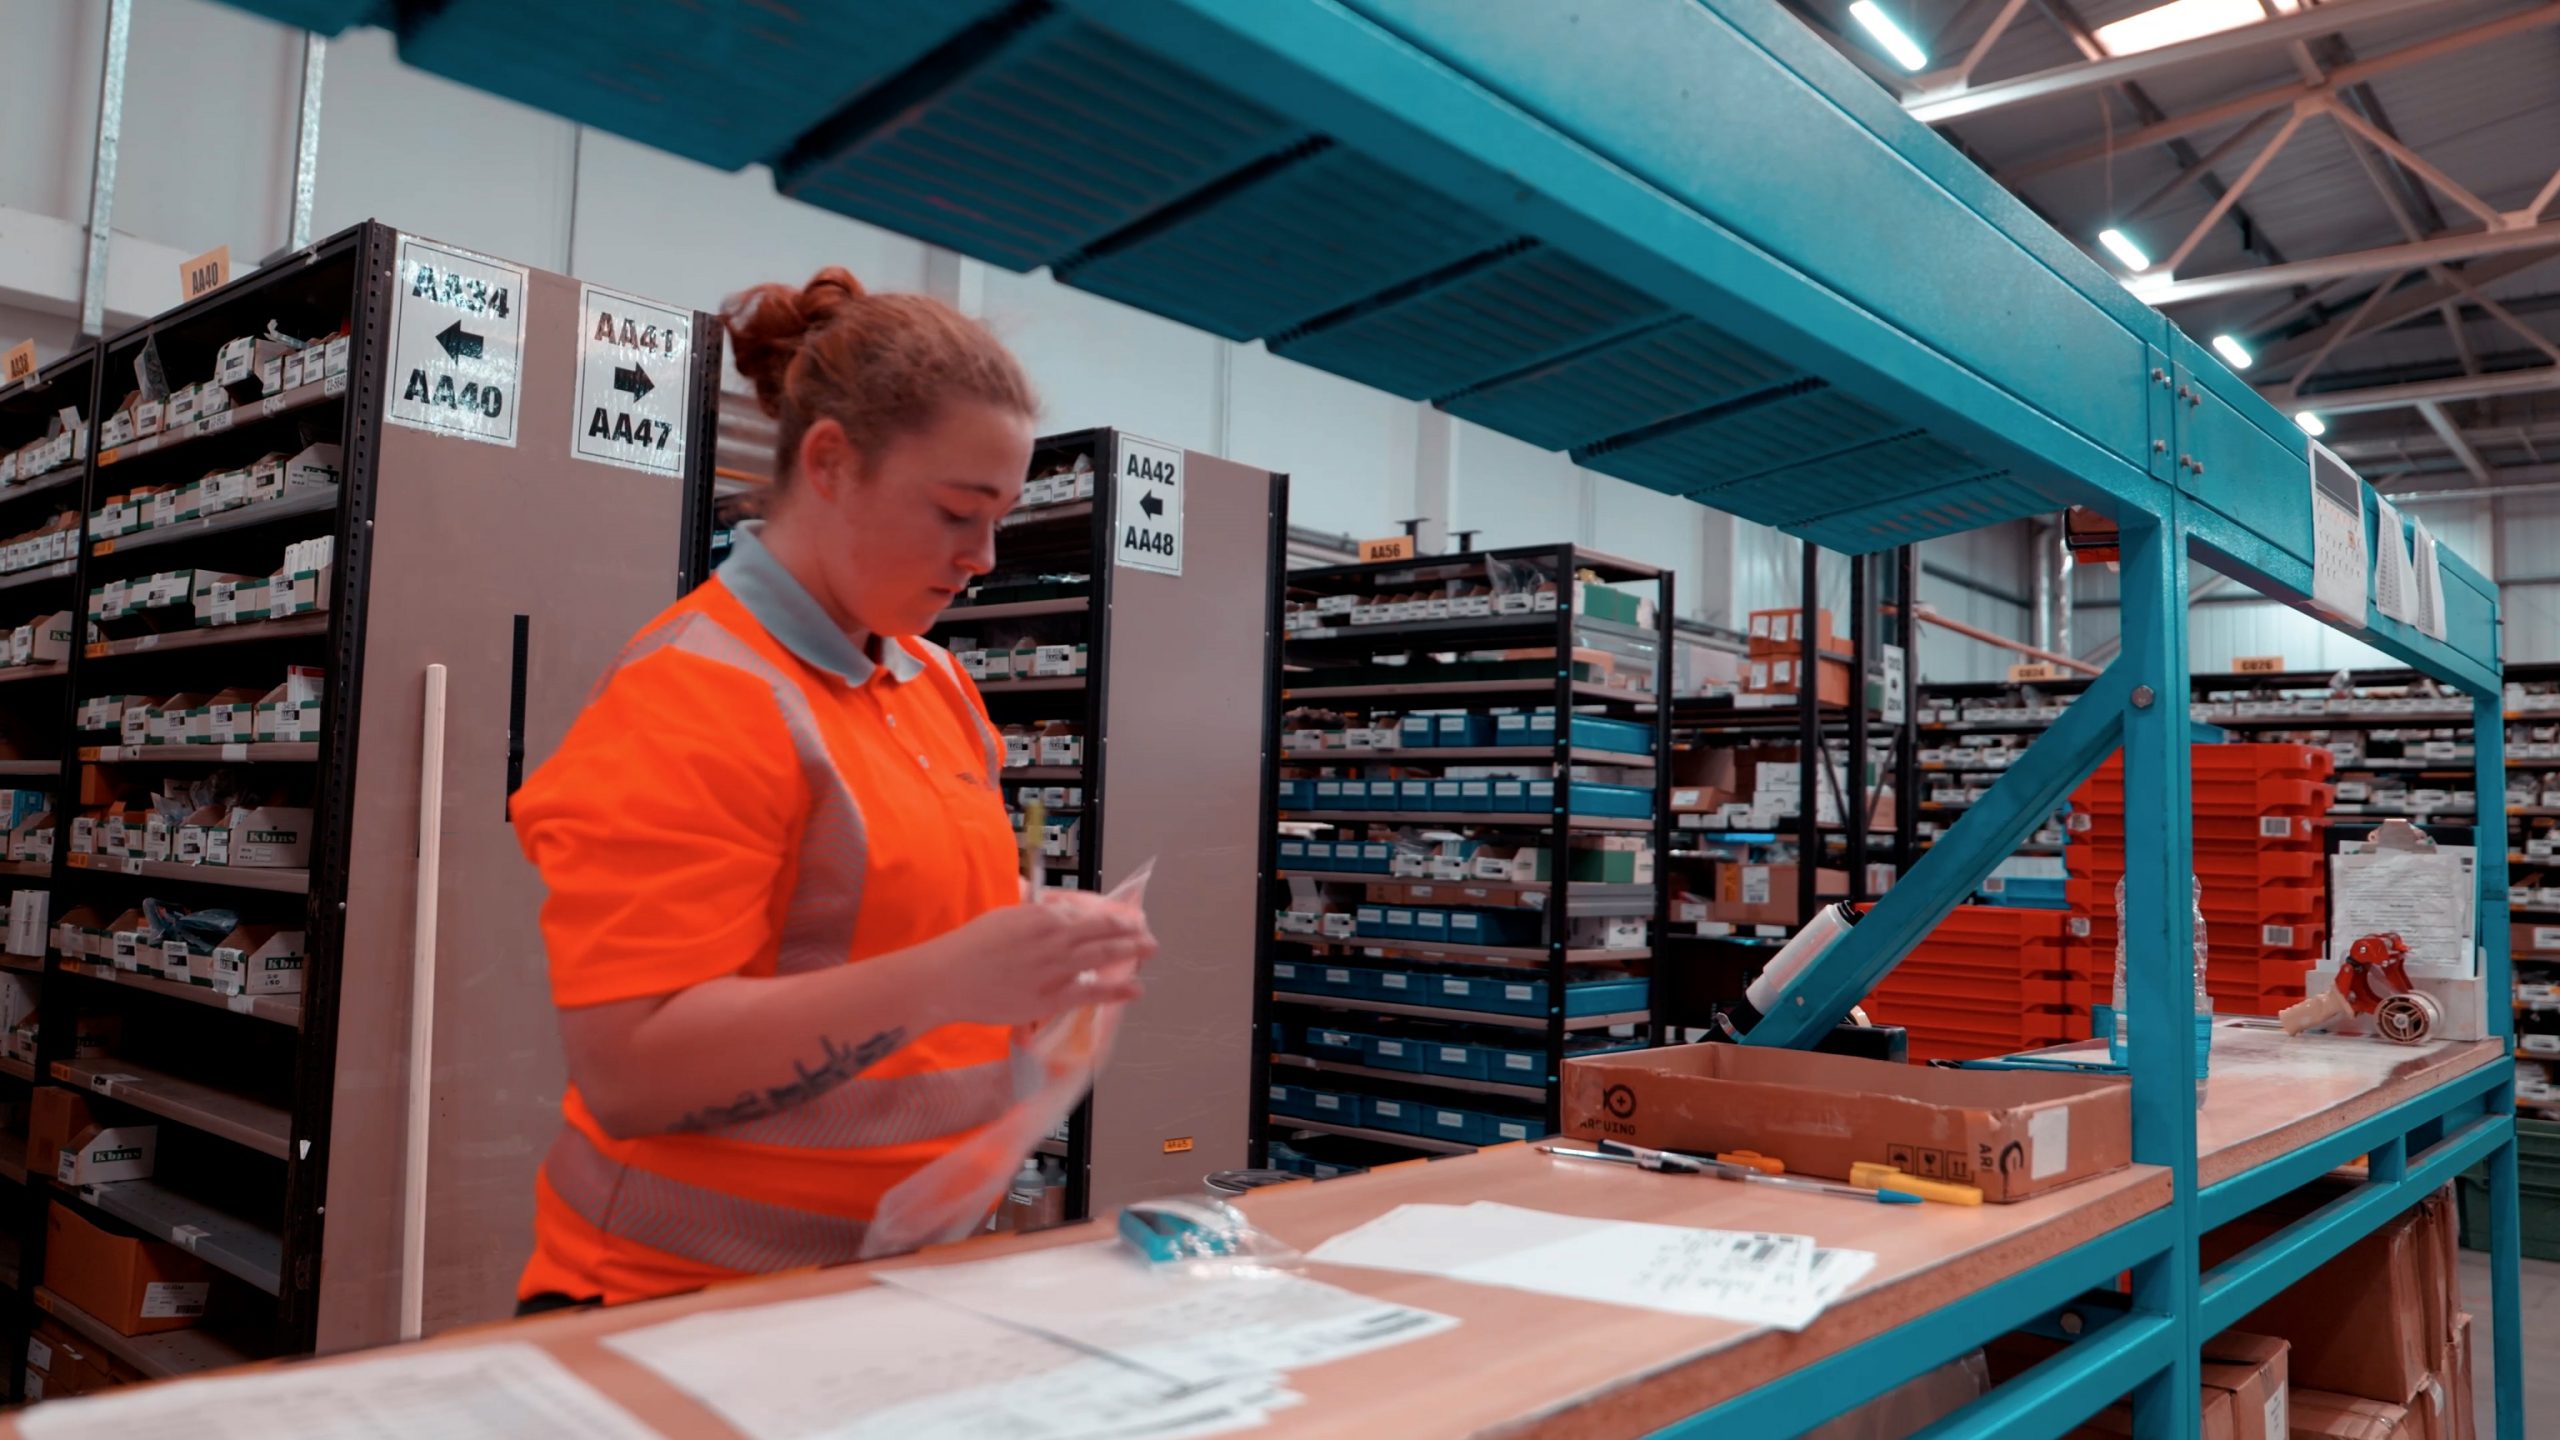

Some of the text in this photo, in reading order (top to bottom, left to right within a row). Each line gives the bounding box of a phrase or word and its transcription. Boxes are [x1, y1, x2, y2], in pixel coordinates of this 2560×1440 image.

[192, 262, 218, 295] AA40
[412, 265, 510, 319] AA34
[594, 312, 674, 358] AA41
[403, 368, 503, 418] AA40
[588, 407, 672, 450] AA47
[1127, 453, 1175, 486] AA42
[1125, 525, 1173, 556] AA48
[1371, 543, 1401, 560] AA56
